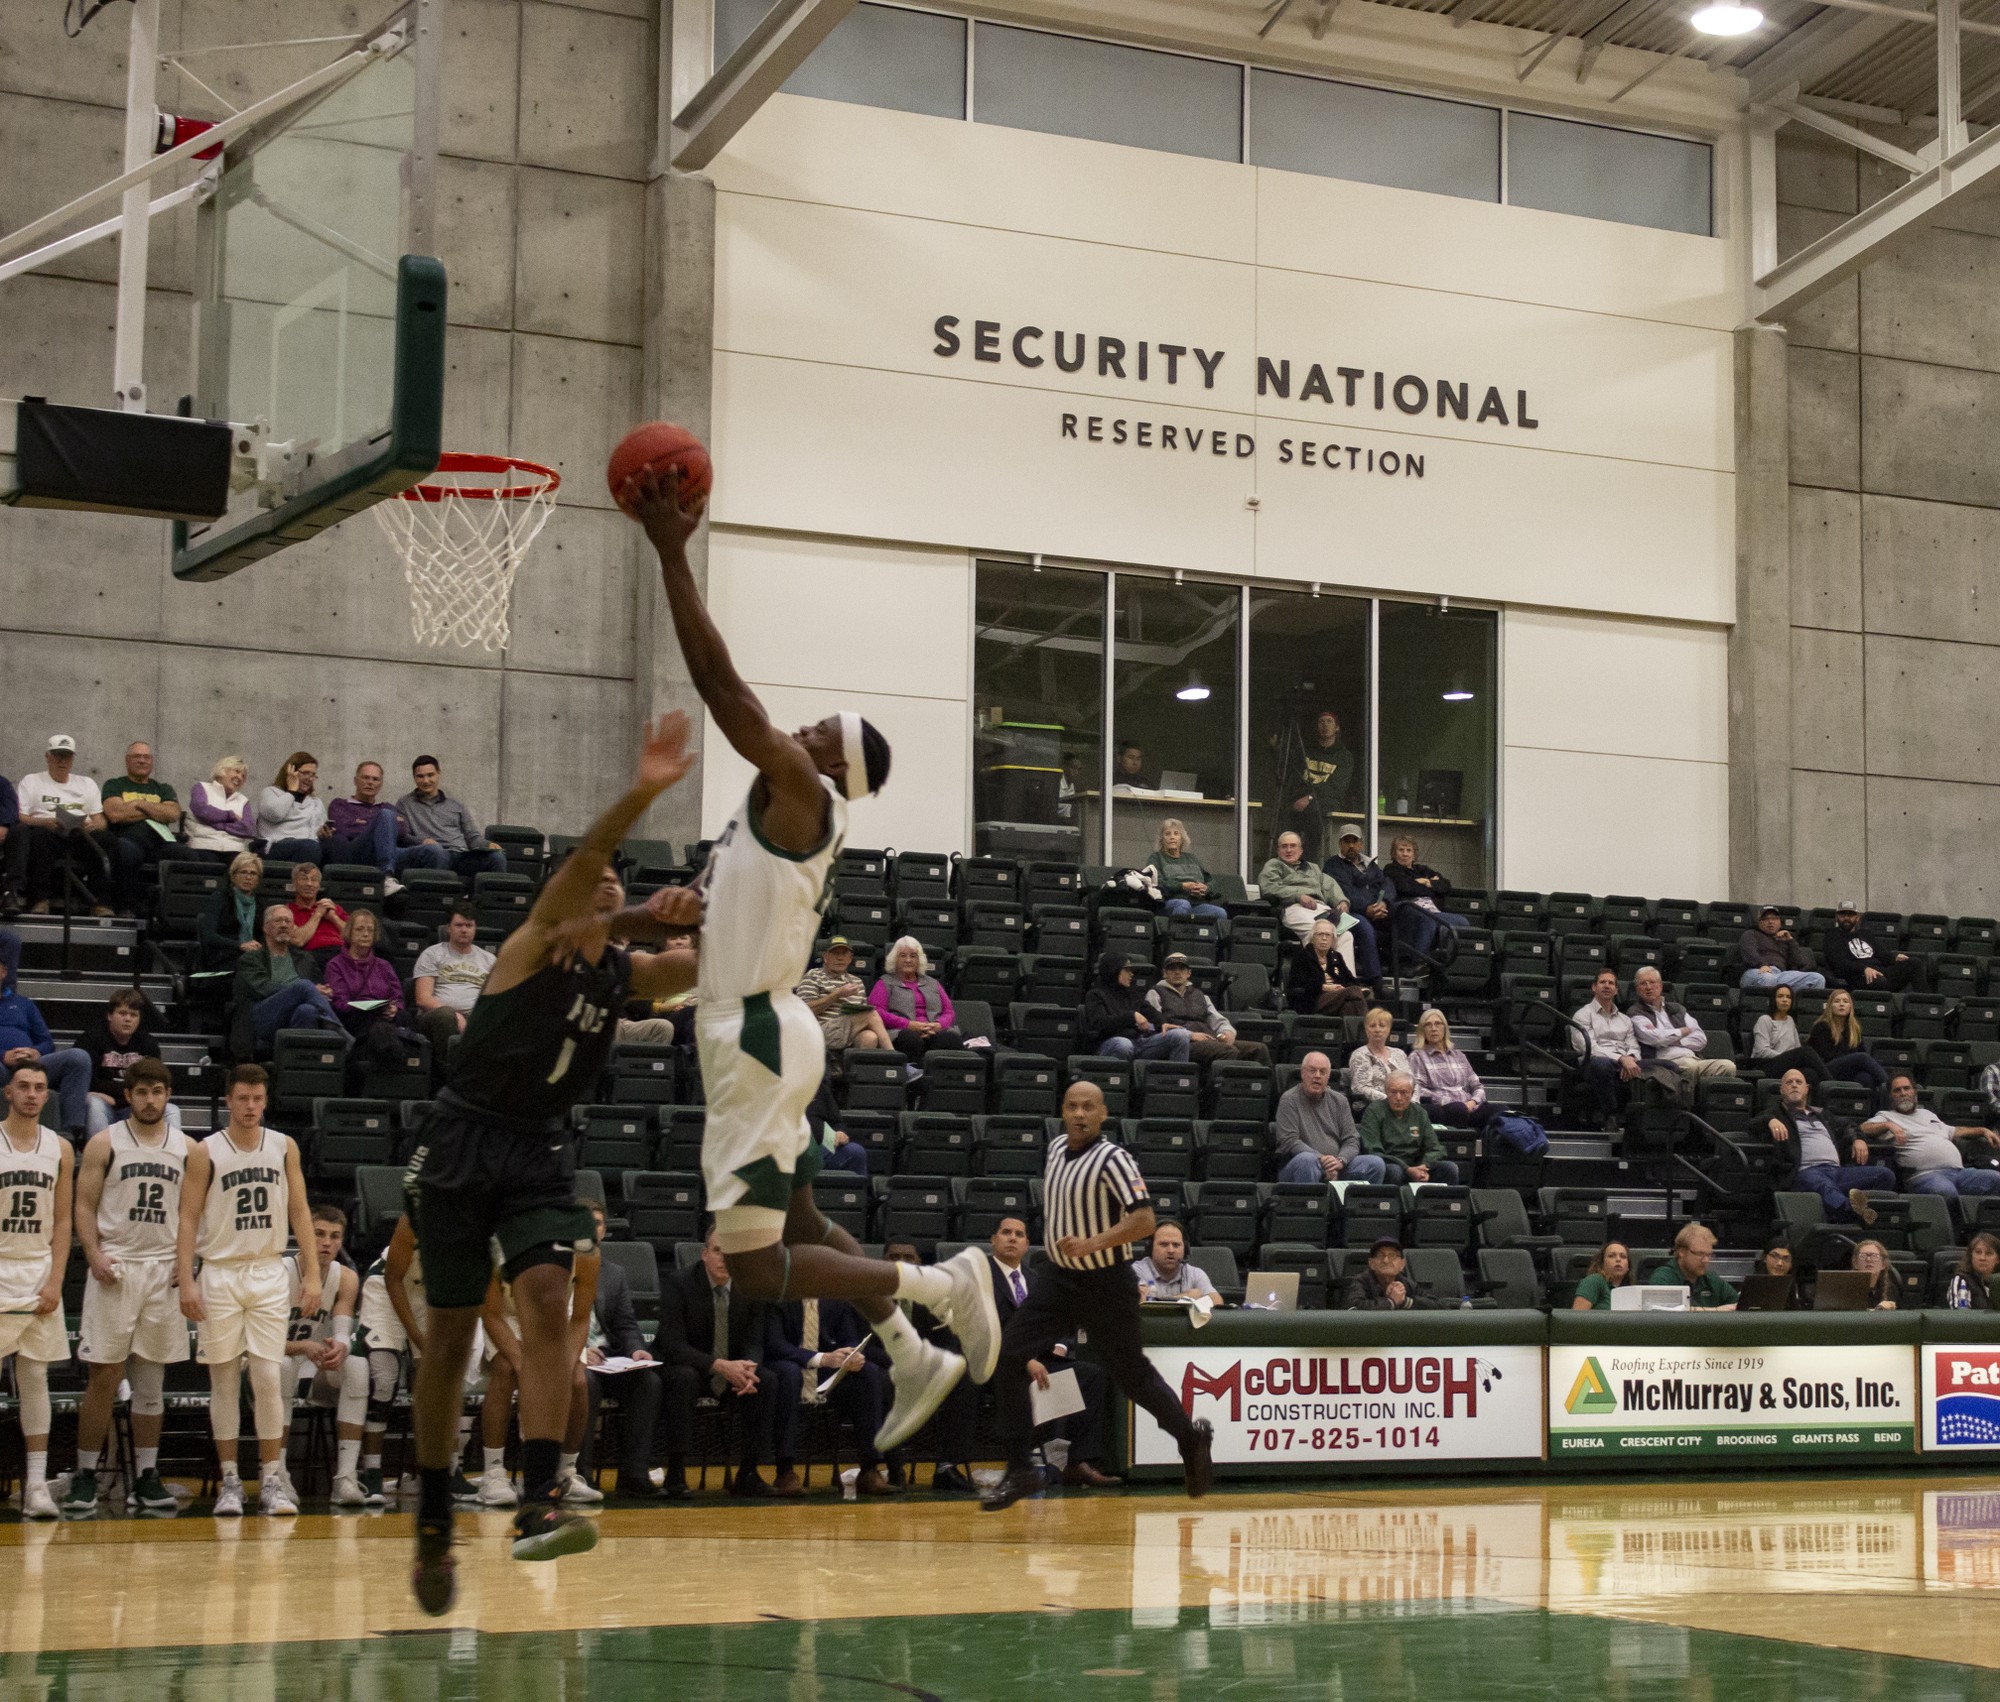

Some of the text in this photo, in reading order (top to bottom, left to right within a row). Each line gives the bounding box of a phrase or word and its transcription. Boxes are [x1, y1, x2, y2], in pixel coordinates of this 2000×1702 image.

[933, 315, 1539, 429] SECURITY NATIONAL
[1062, 413, 1425, 479] RESERVED SECTION
[10, 1191, 37, 1218] 15
[137, 1182, 164, 1209] 12
[237, 1186, 269, 1215] 20
[129, 1207, 167, 1224] STATE
[235, 1214, 273, 1231] STATE
[2, 1218, 42, 1234] STATE
[1611, 1357, 1764, 1375] Roofing Experts Since 1919
[1950, 1361, 2000, 1385] Pat
[1623, 1377, 1900, 1413] McMurray & Sons, Inc.
[1247, 1401, 1441, 1422] CONSTRUCTION INC.
[1246, 1425, 1440, 1451] 707-825-1014
[1561, 1437, 1605, 1449] EUREKA
[1619, 1435, 1702, 1448] CRESCENT CITY
[1716, 1434, 1778, 1446] BROOKINGS
[1791, 1432, 1860, 1444] GRANTS PASS
[1873, 1431, 1902, 1443] BEND
